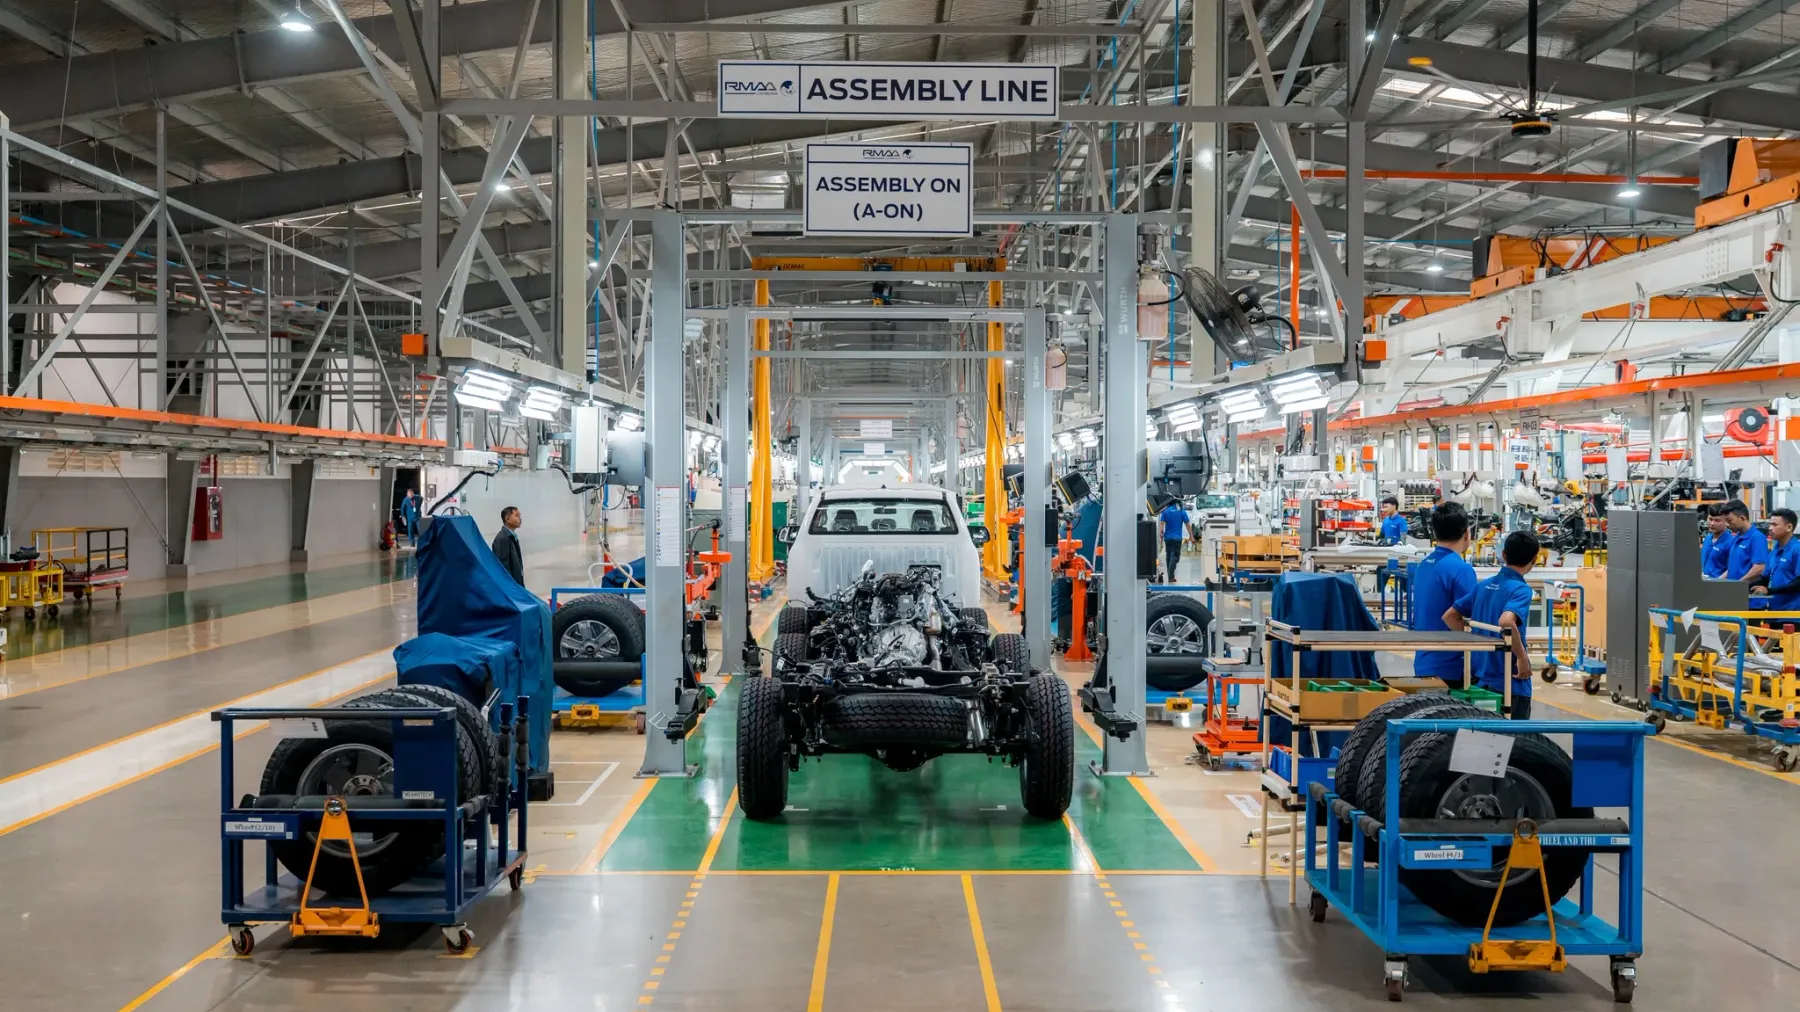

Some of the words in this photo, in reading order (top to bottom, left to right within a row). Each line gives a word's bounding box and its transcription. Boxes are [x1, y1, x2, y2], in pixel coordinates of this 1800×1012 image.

[806, 78, 974, 101] ASSEMBLY
[981, 80, 1048, 102] LINE
[816, 176, 926, 193] ASSEMBLY
[930, 178, 961, 193] ON
[853, 202, 923, 222] (A-ON)
[1563, 836, 1579, 846] AND
[1579, 836, 1598, 846] TIRE
[1424, 851, 1445, 859] Wheel
